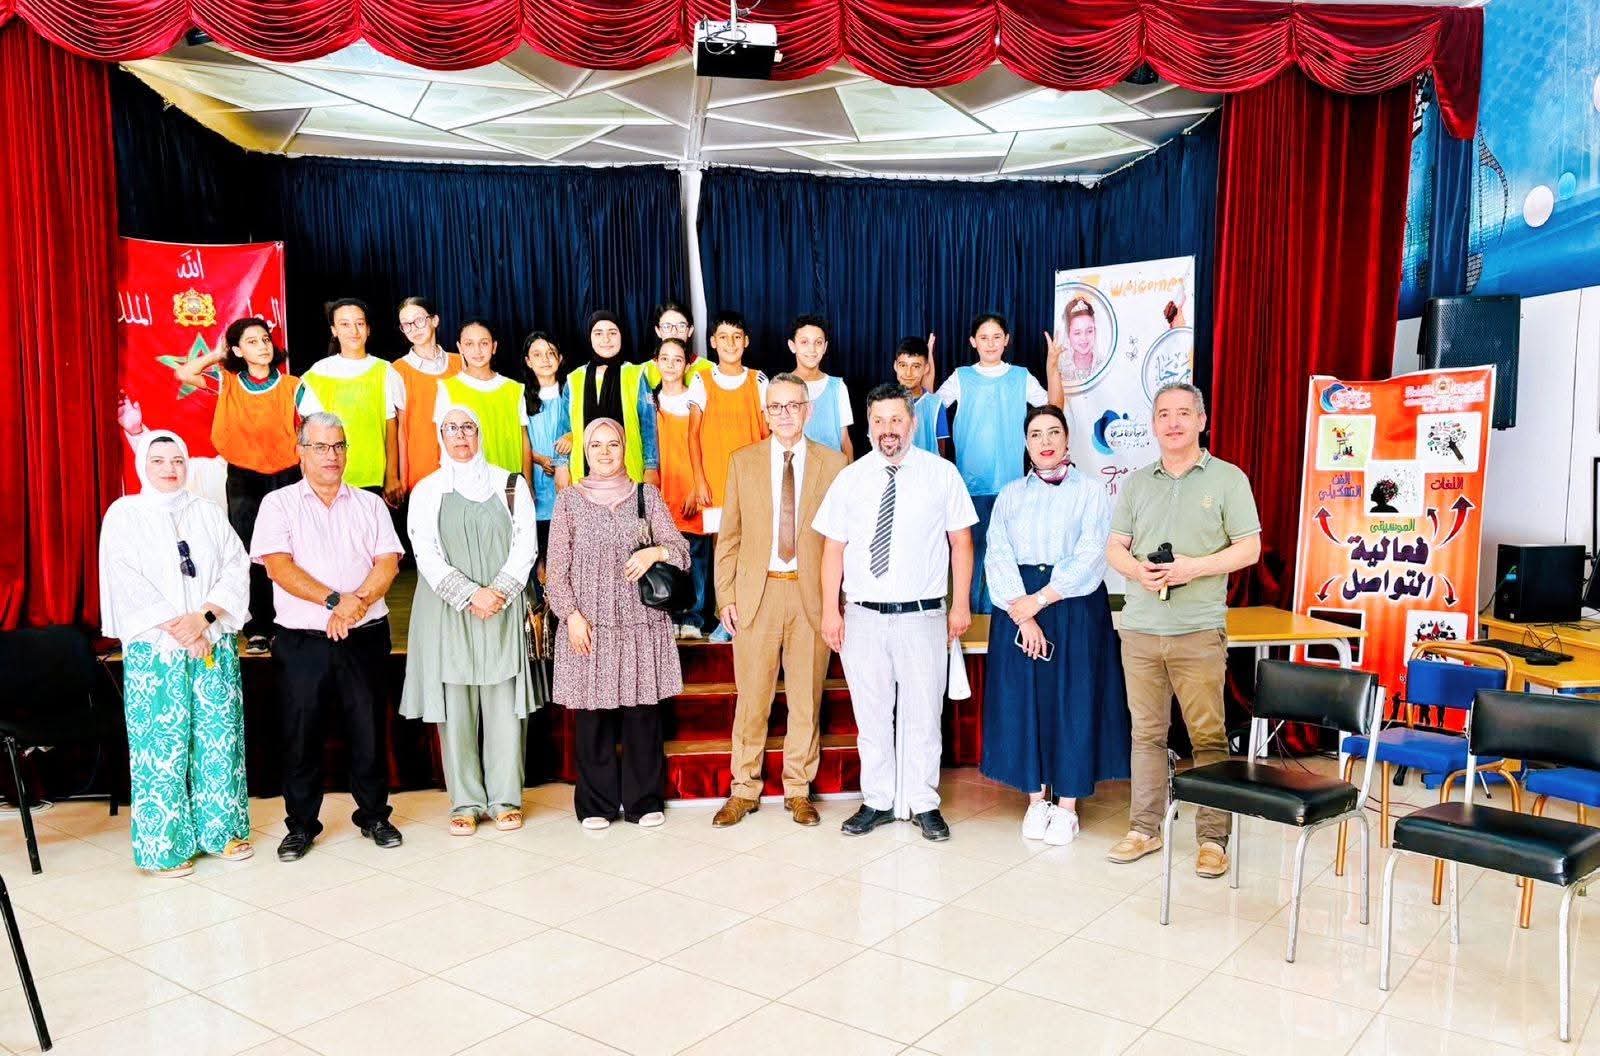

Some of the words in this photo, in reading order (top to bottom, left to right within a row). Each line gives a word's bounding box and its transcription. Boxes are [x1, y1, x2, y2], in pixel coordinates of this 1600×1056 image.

[177, 249, 204, 279] الله
[1430, 476, 1464, 490] اللغات
[1347, 535, 1429, 568] فعالية
[1342, 568, 1434, 601] التواصل
